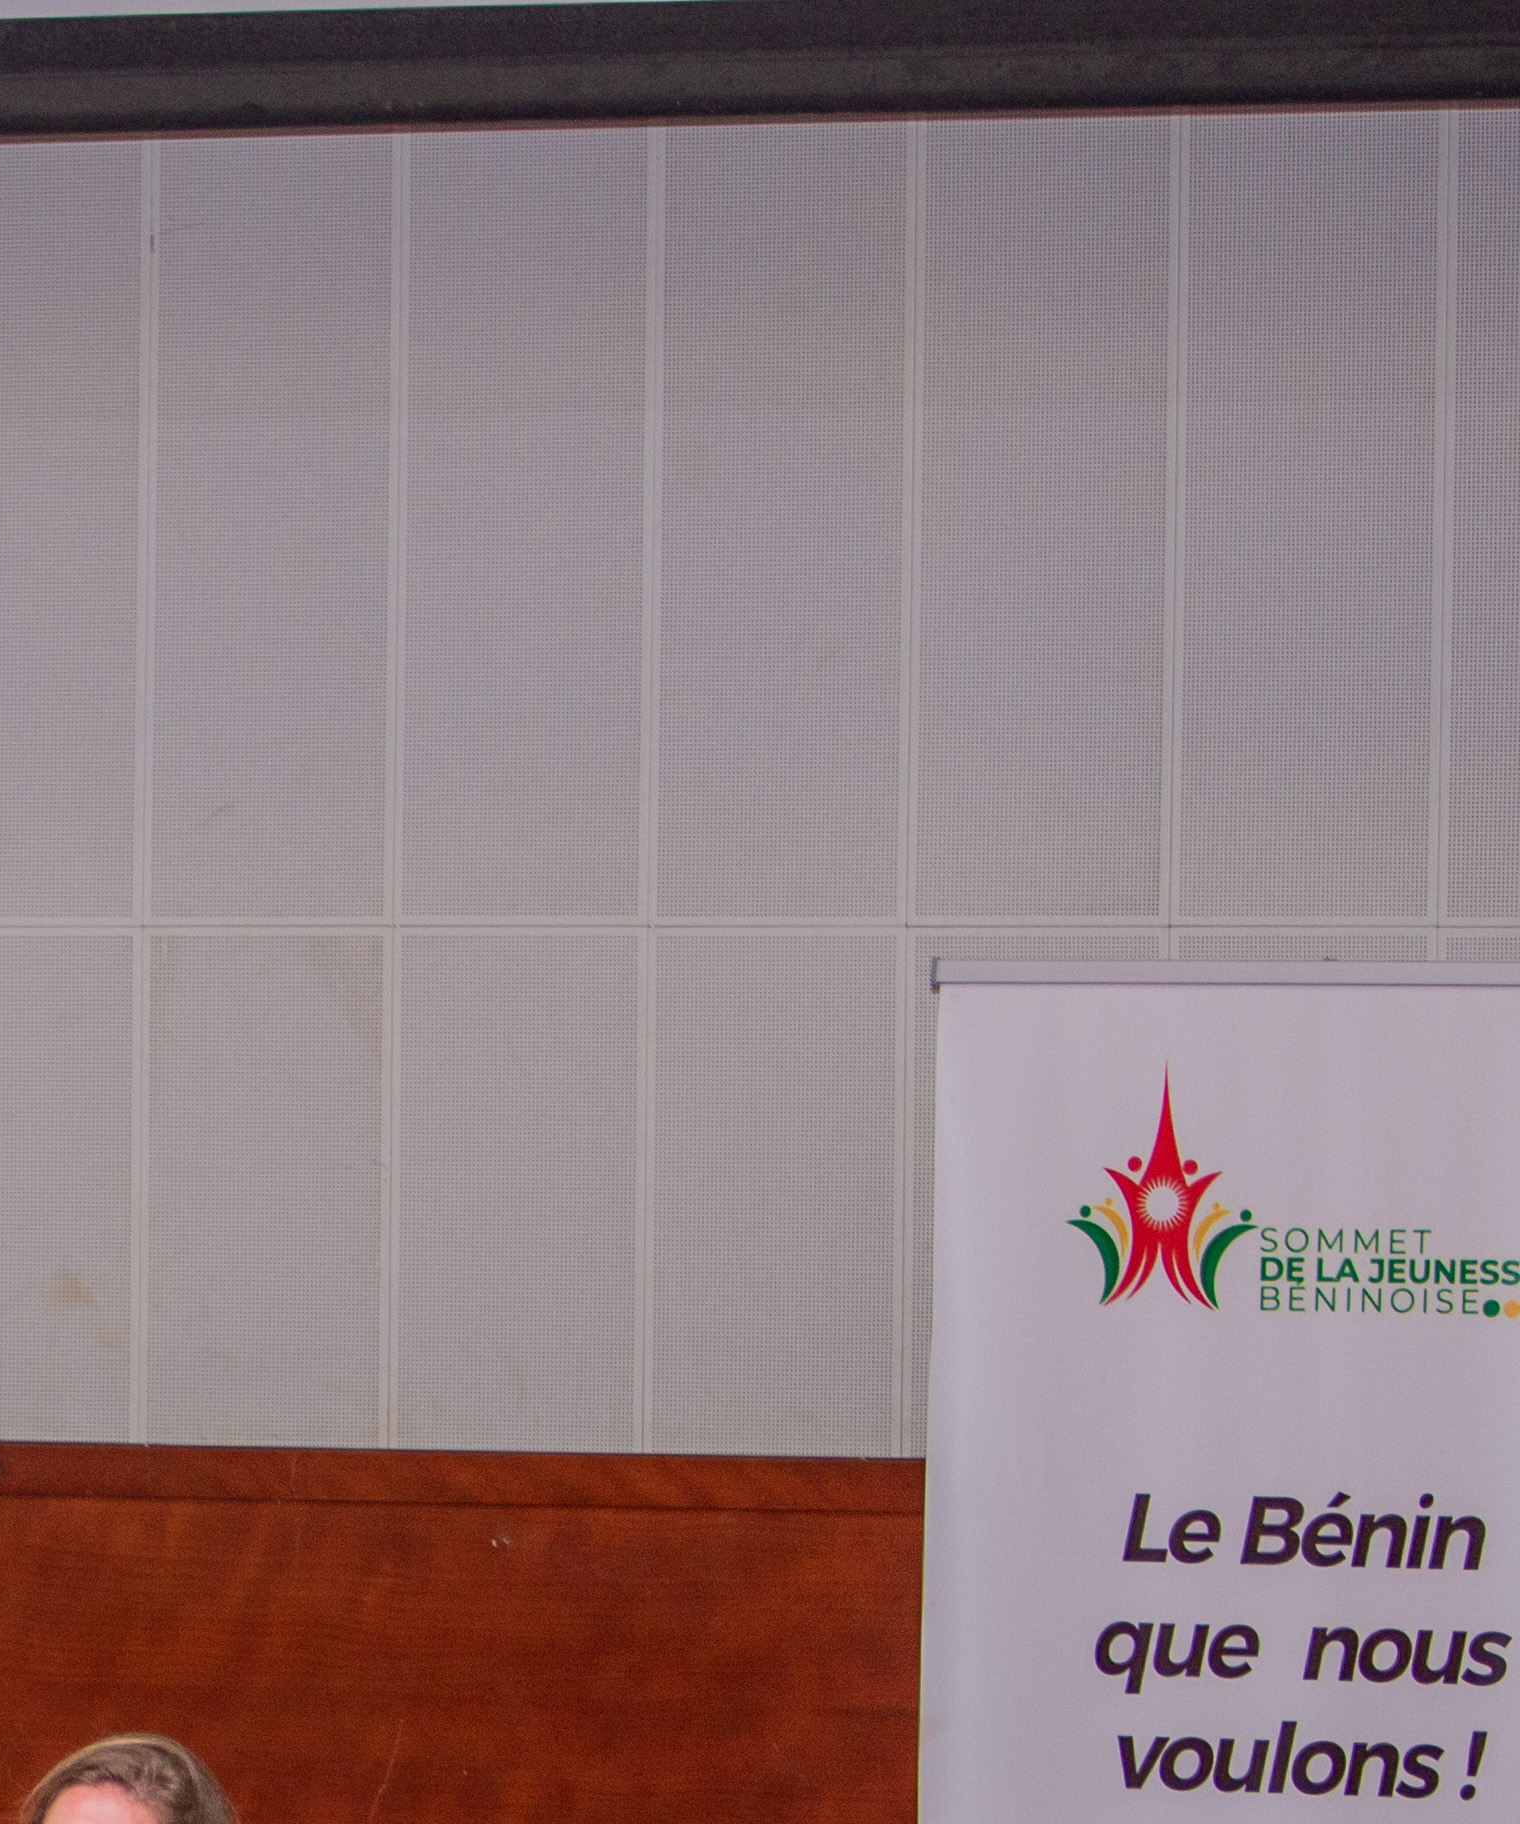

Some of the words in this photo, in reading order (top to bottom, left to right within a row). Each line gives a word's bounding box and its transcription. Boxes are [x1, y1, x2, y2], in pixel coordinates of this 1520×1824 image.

[1261, 1227, 1431, 1254] SOMMET
[1261, 1257, 1304, 1283] DE
[1317, 1258, 1359, 1282] LA
[1369, 1259, 1520, 1285] JEUNESS
[1260, 1281, 1478, 1314] BÉNINOISE
[1123, 1494, 1221, 1563] Le
[1241, 1492, 1486, 1570] Bénin
[1095, 1622, 1260, 1694] que
[1303, 1627, 1512, 1686] nous
[1118, 1721, 1444, 1798] voulons
[1460, 1731, 1487, 1800] !
